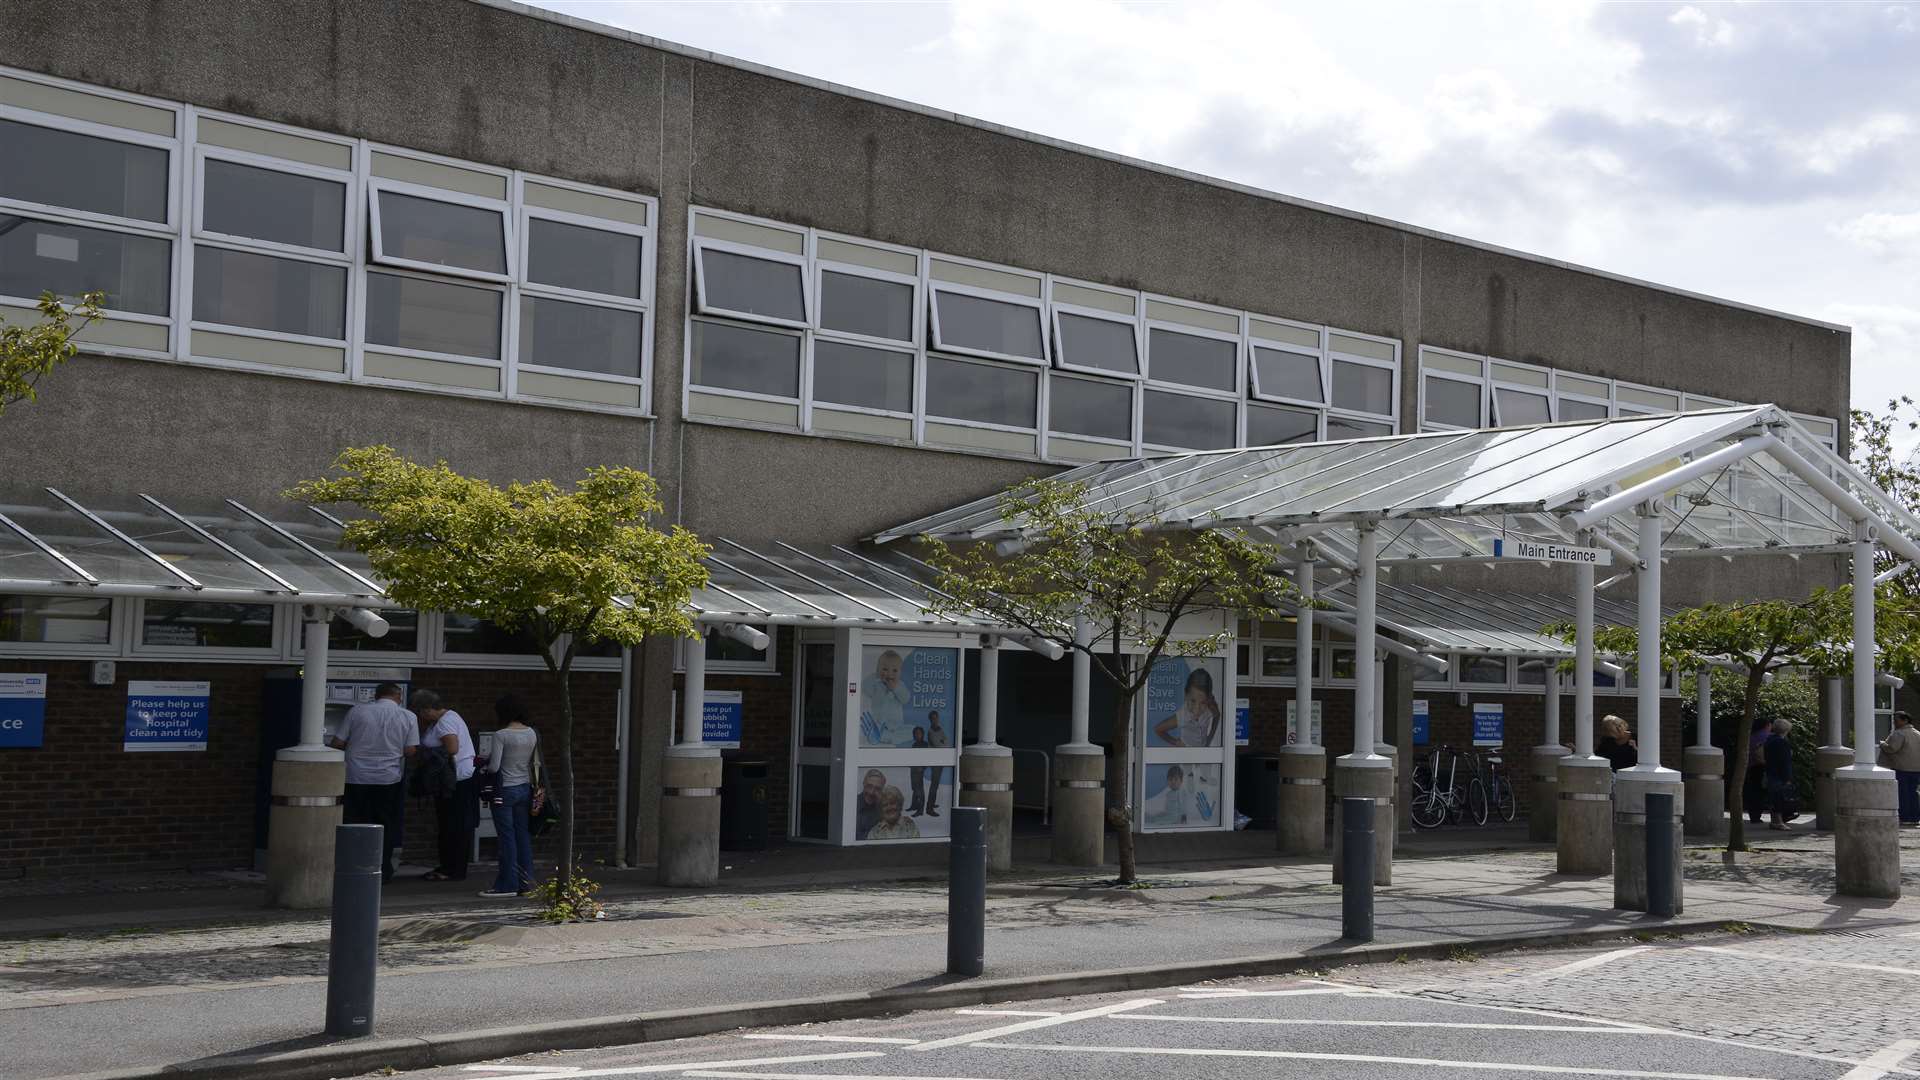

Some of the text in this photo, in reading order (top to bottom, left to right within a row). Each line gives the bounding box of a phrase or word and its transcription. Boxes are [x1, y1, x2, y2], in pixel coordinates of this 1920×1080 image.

[1518, 543, 1596, 561] Main Entrance
[913, 651, 948, 665] Clean
[913, 666, 952, 679] Hands
[912, 681, 944, 693] Save
[1149, 687, 1175, 697] Save
[132, 700, 165, 708] Please
[167, 700, 190, 709] help
[912, 695, 946, 708] Lives
[1149, 700, 1177, 711] Lives
[152, 710, 177, 719] keep
[720, 706, 732, 714] put
[146, 719, 190, 728] Hospital
[129, 729, 203, 738] clean and tidy
